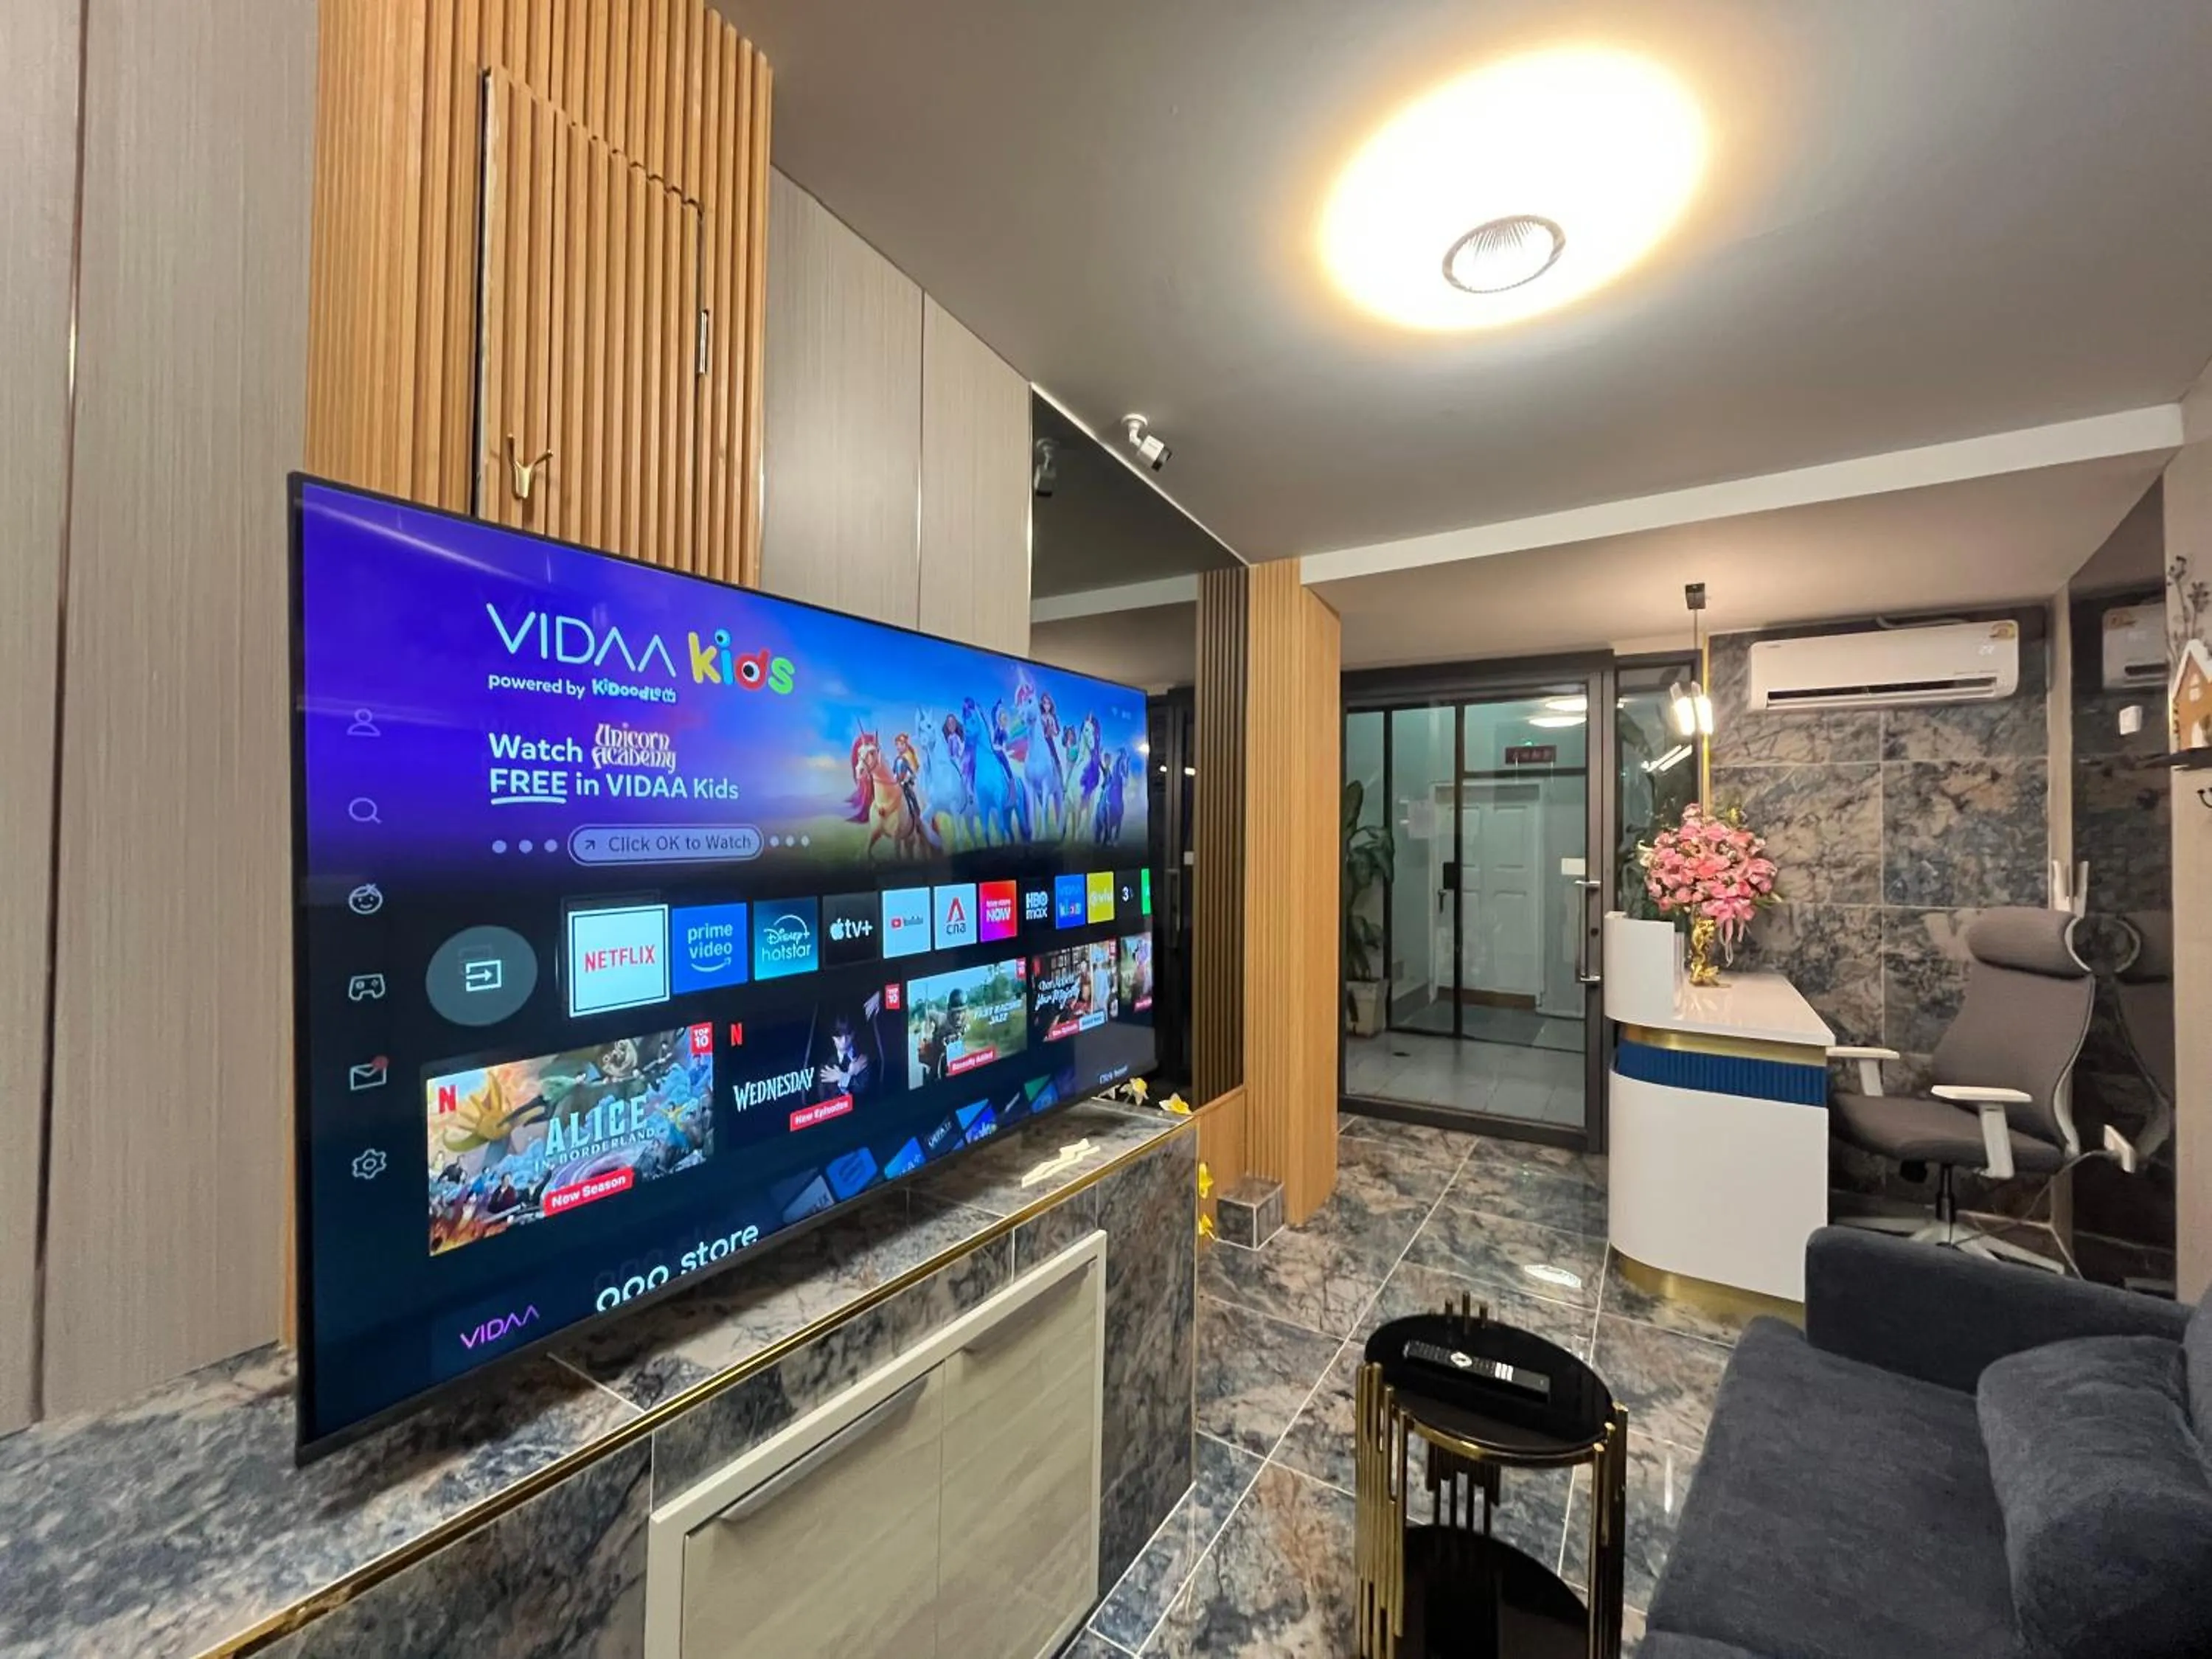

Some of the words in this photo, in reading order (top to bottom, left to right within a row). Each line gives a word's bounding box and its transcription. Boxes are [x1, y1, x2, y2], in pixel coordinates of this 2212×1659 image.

[486, 602, 677, 678] VIDAA
[688, 628, 796, 695] kids
[488, 673, 563, 695] powered
[566, 679, 585, 700] by
[489, 732, 583, 763] Watch
[594, 722, 670, 751] Unicorn
[591, 745, 677, 775] Academy
[490, 768, 567, 796] FREE
[576, 772, 599, 796] in
[605, 773, 688, 799] VIDAA
[693, 777, 740, 800] Kids
[608, 835, 653, 852] Click
[655, 835, 680, 852] OK
[686, 835, 701, 851] to
[706, 834, 751, 851] Watch
[1026, 891, 1048, 908] HBO
[986, 907, 1011, 922] NOW
[1026, 907, 1048, 921] max
[687, 922, 734, 944] prime
[946, 922, 967, 936] cna
[584, 945, 655, 973] NETFLIX
[689, 942, 733, 959] video
[762, 942, 811, 962] hotstar
[693, 1027, 709, 1038] TOP
[695, 1037, 709, 1048] 10
[733, 1067, 815, 1112] WEDNESDAY
[546, 1094, 650, 1156] ALICE
[795, 1112, 813, 1125] New
[559, 1128, 655, 1165] BORDERLAND
[582, 1175, 626, 1196] Season
[680, 1225, 759, 1275] store
[460, 1304, 540, 1349] VIDAA
